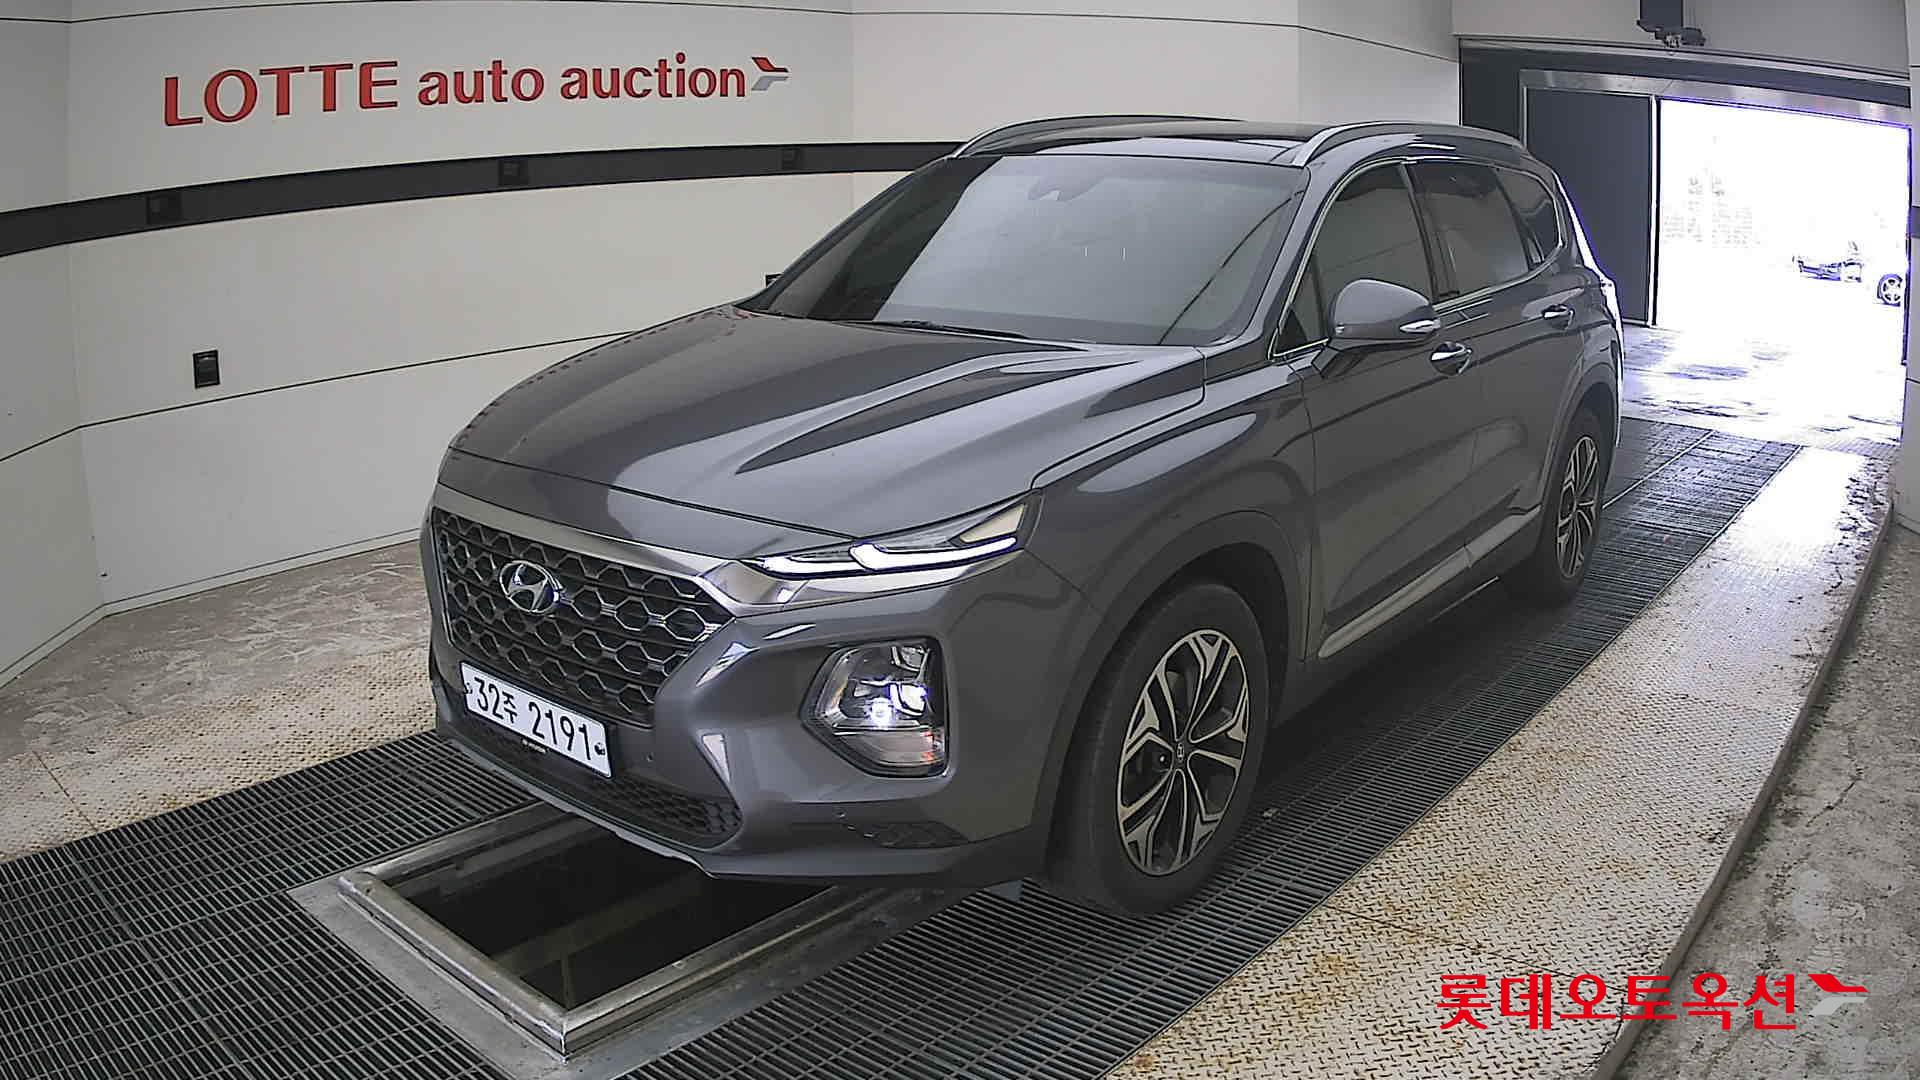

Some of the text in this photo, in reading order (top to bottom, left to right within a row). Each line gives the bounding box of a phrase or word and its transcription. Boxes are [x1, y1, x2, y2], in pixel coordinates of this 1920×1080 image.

[163, 53, 746, 127] LOTTE auto auction
[473, 677, 591, 760] 32주 2191
